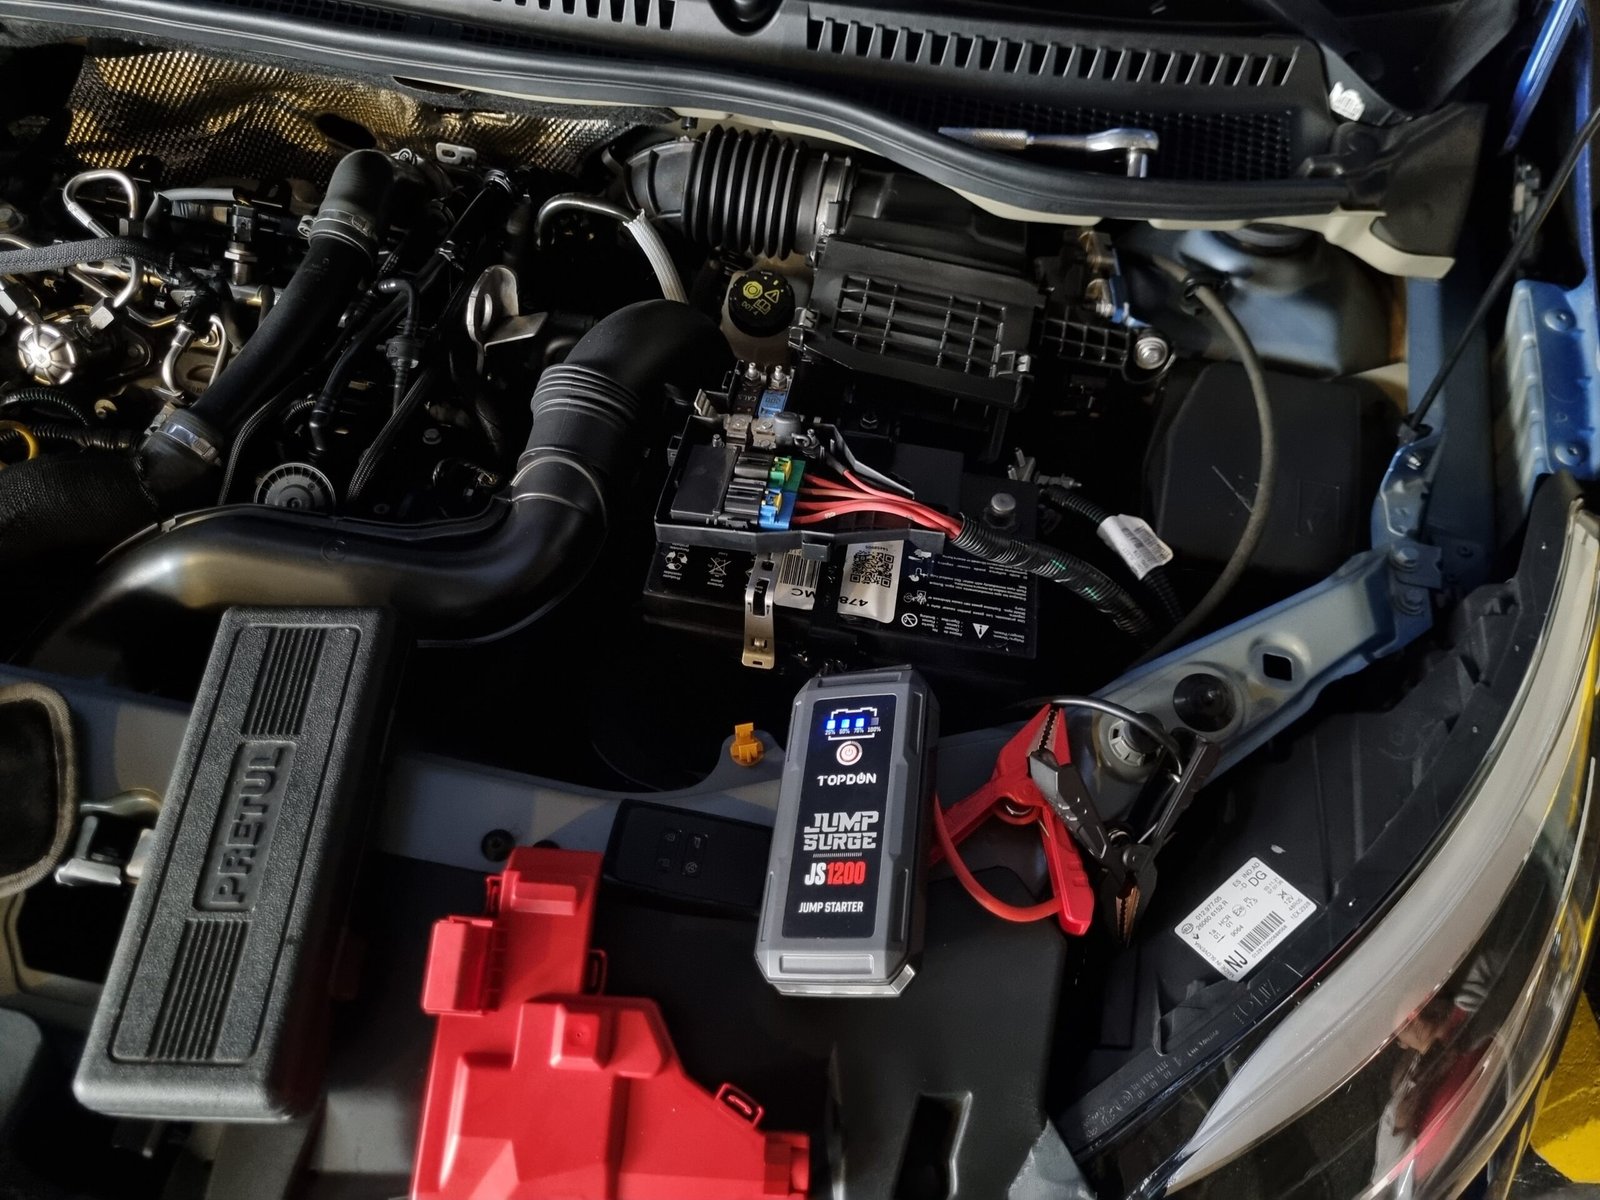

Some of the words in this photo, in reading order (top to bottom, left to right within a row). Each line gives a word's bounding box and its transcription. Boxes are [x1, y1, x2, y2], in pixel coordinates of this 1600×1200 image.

[741, 300, 754, 313] DOT
[839, 596, 868, 608] 478
[817, 773, 877, 786] TOPDON
[210, 746, 285, 906] PRETUL
[804, 810, 879, 833] JUMP
[803, 832, 877, 851] SURGE
[804, 861, 866, 886] JS1200
[1248, 870, 1267, 887] DG
[798, 901, 824, 914] JUMP
[824, 900, 864, 914] STARTER
[1218, 914, 1231, 927] HCR
[1223, 949, 1248, 973] NJ
